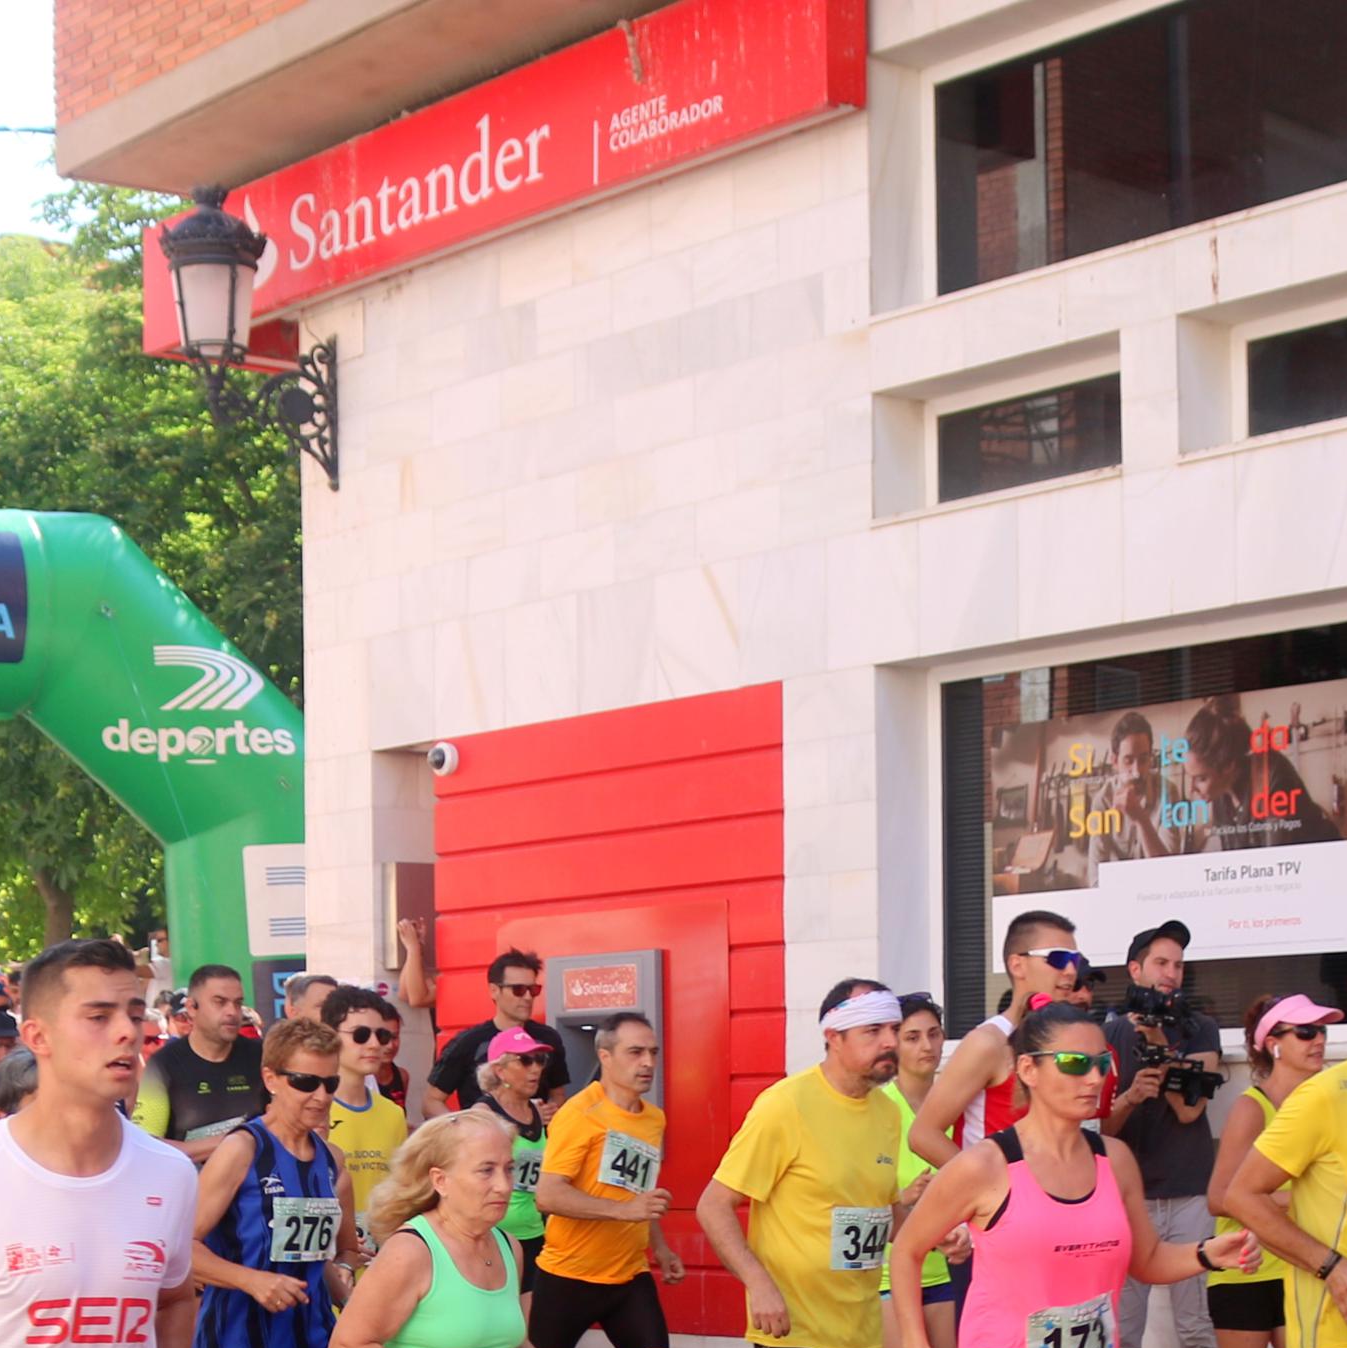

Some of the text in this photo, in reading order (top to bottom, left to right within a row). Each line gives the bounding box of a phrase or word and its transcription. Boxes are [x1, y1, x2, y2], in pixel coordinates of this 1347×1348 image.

[608, 95, 724, 152] COLABORADOR
[609, 95, 668, 134] AGENTE
[290, 113, 551, 271] Santander
[101, 718, 296, 763] deportes
[1068, 719, 1291, 778] Si te da
[1069, 787, 1302, 839] San tan der
[1279, 818, 1302, 831] Pagos
[1204, 861, 1302, 883] Tarifa Plana TPV
[583, 981, 629, 996] Santander
[611, 1148, 651, 1188] 441
[283, 1216, 334, 1252] 276
[1054, 1239, 1121, 1253] EVERYTHING
[25, 1296, 153, 1345] SER
